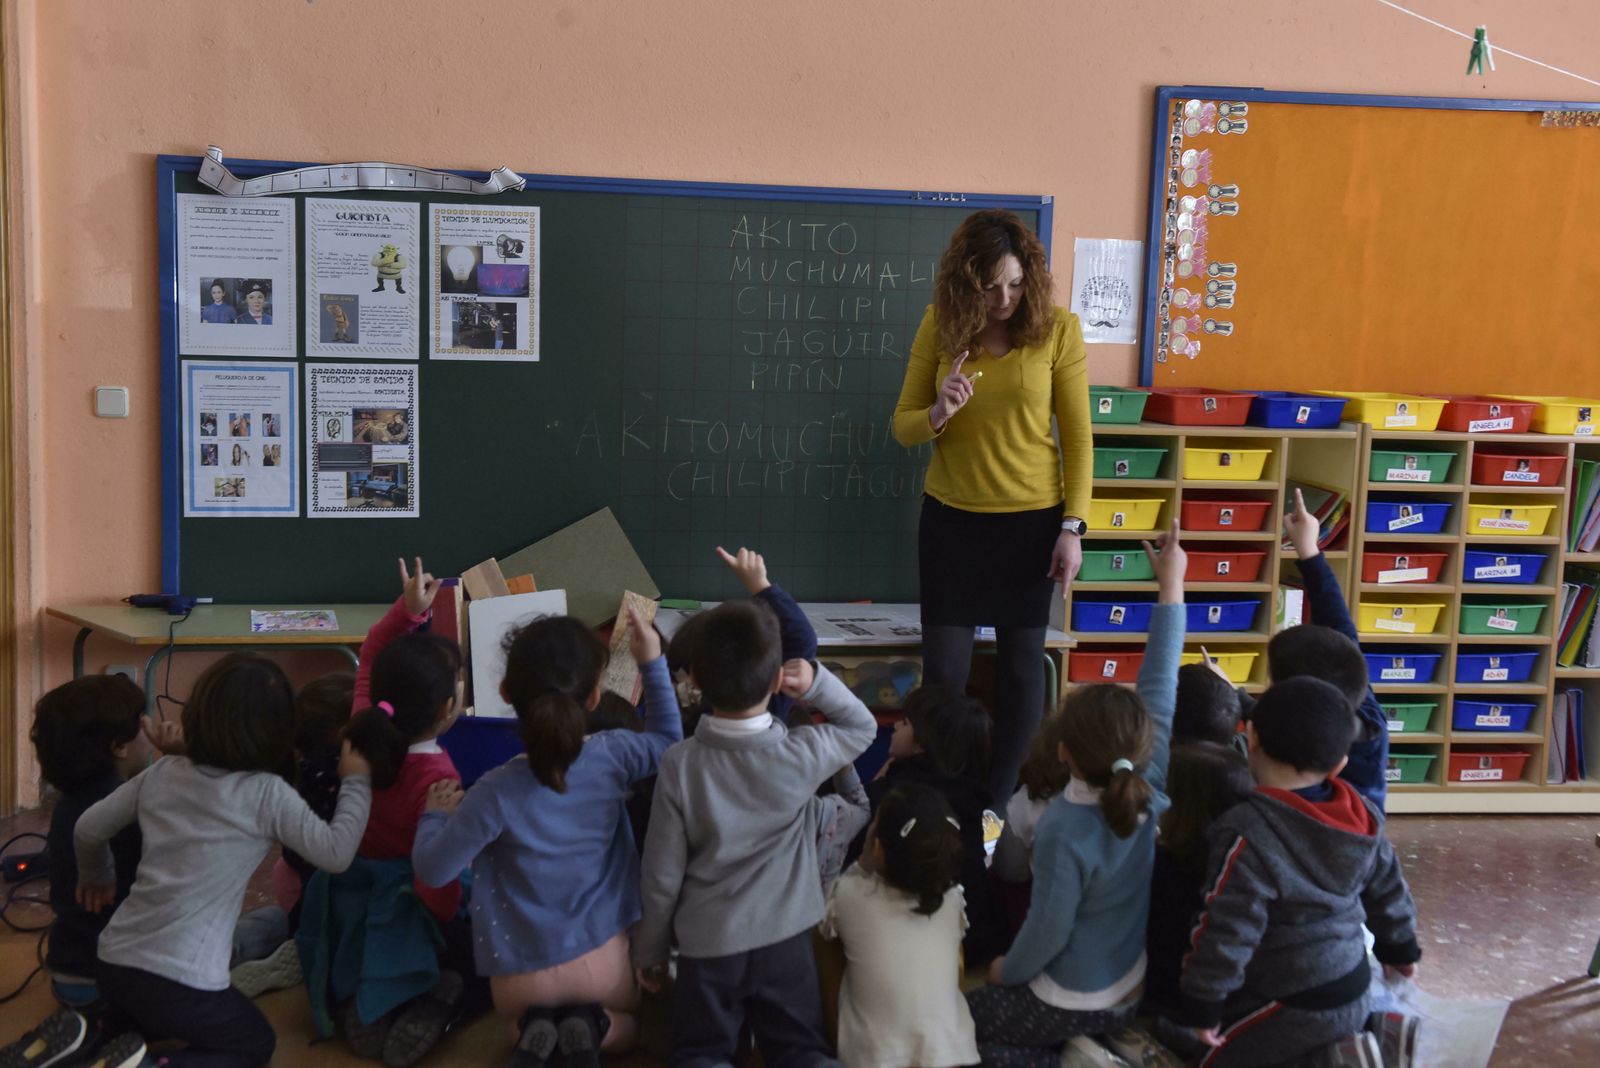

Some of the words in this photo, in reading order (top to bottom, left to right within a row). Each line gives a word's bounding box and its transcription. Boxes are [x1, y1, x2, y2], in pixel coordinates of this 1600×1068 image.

[335, 211, 391, 222] GUIONISTA
[729, 215, 857, 255] AKITO
[737, 286, 886, 322] CHILIPI
[741, 327, 902, 358] JAGÜIR
[358, 376, 371, 384] DE
[373, 376, 404, 385] SONIDO
[1389, 472, 1418, 480] MARINA
[1504, 472, 1538, 481] CANDELA
[1390, 515, 1420, 529] AURORA
[1498, 521, 1529, 529] DOMINGO
[1476, 569, 1507, 577] MARINA
[1477, 716, 1509, 724] CLAUDIA
